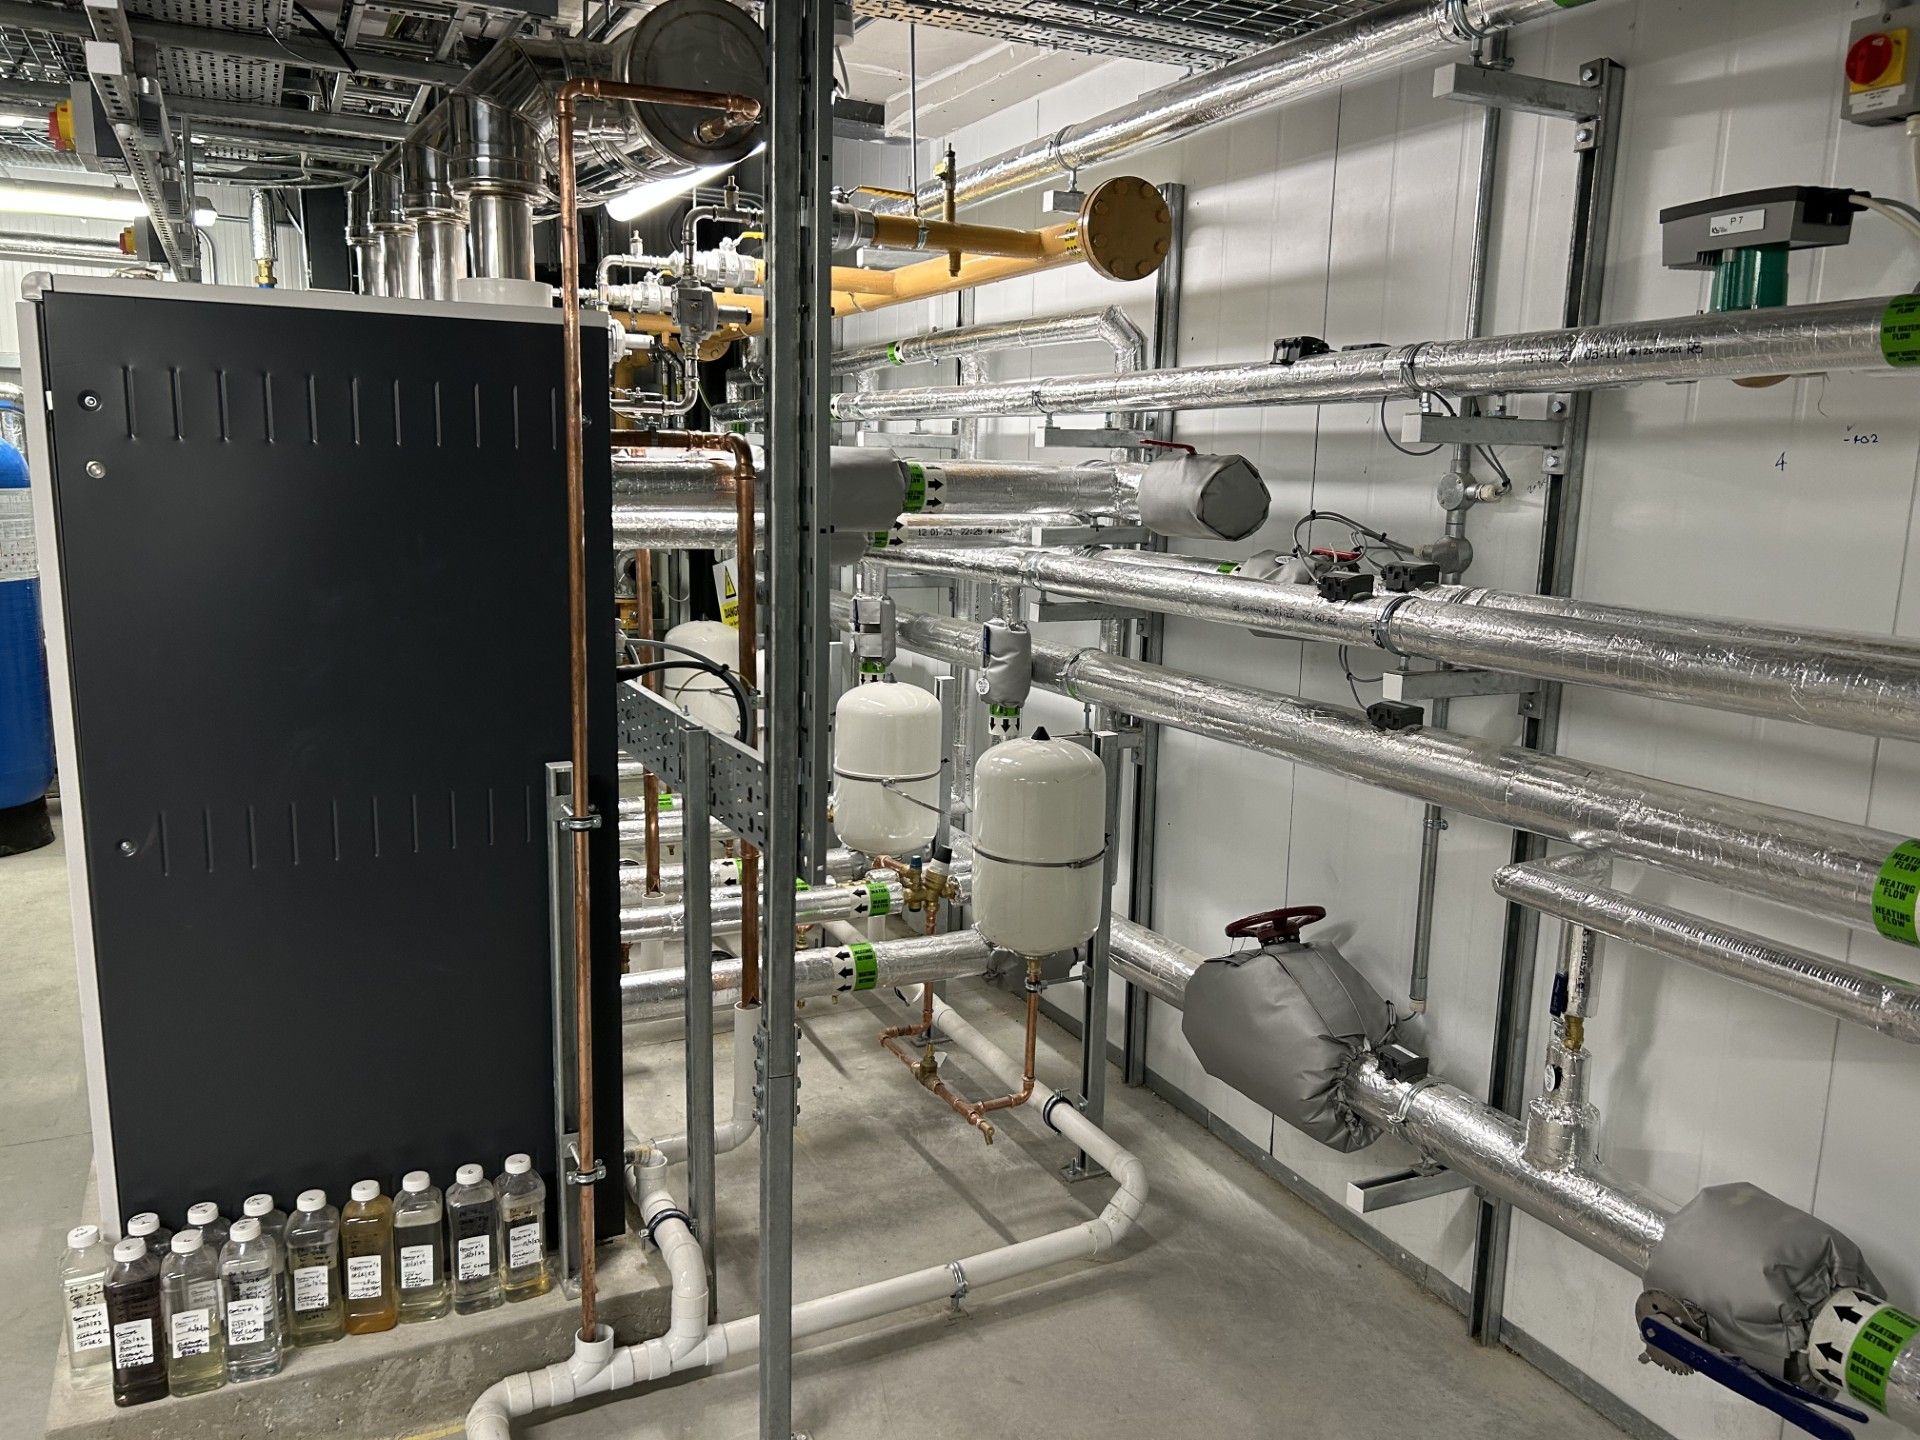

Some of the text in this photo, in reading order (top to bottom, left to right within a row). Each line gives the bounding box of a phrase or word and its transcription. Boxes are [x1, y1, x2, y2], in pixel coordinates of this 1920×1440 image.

[1892, 332, 1911, 340] FLOW
[1775, 451, 1788, 472] 4
[1894, 861, 1919, 872] FLOW
[1880, 877, 1916, 894] HEATING
[1883, 887, 1907, 901] FLOW
[1875, 905, 1911, 922] HEATING
[1882, 915, 1905, 928] FLOW
[1867, 1321, 1903, 1344] HEATING
[1863, 1330, 1895, 1353] RETURN
[1851, 1351, 1885, 1376] HEATING
[1849, 1362, 1881, 1386] RETURN
